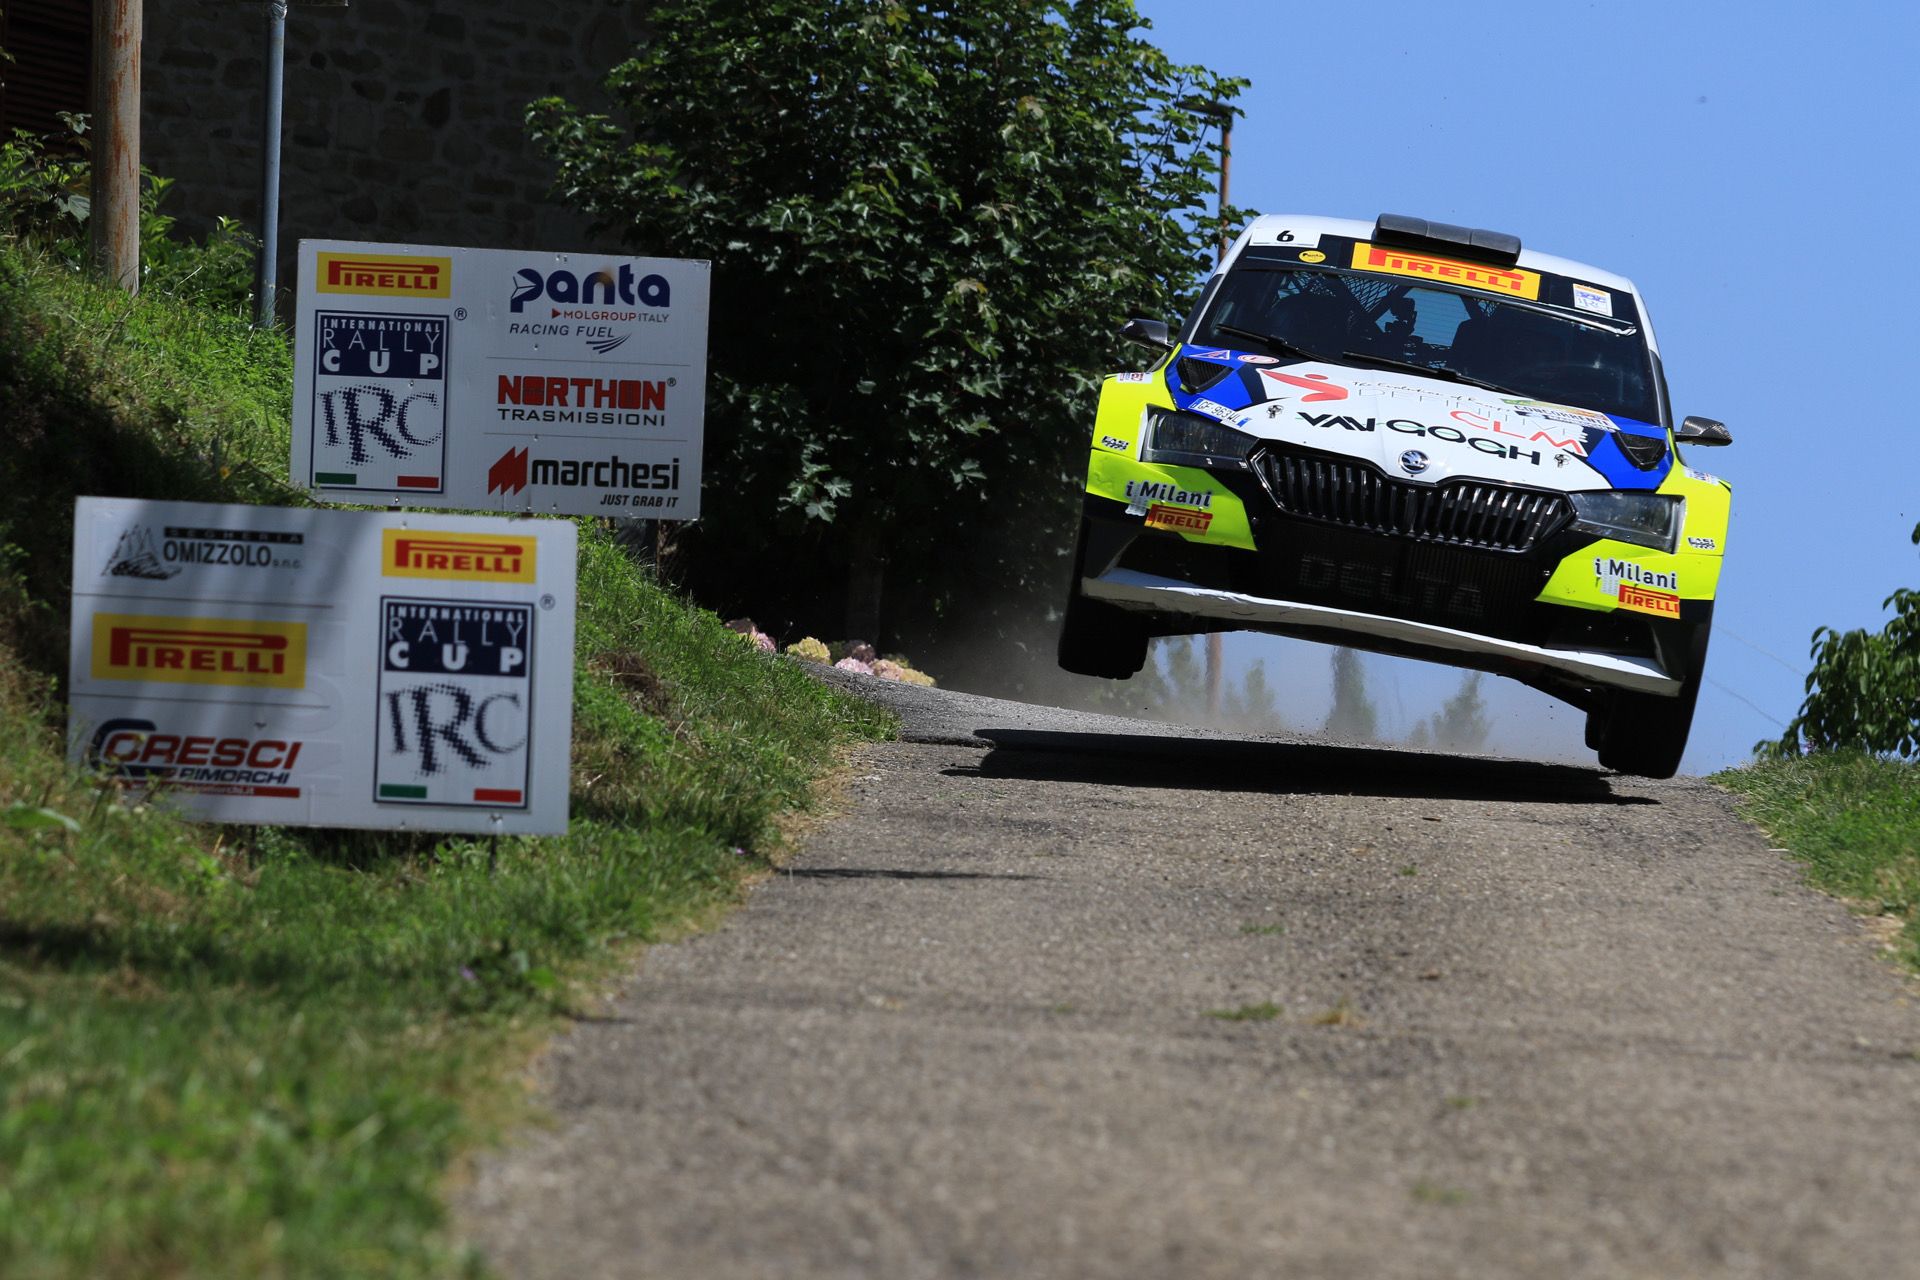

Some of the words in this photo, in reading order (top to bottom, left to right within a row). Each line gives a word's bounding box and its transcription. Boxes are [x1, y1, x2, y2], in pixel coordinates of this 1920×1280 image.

[1276, 230, 1295, 242] 6
[328, 260, 440, 290] PIRELLI
[1367, 247, 1525, 291] PIRELLI
[510, 263, 671, 313] panta
[323, 318, 440, 333] INTERNATIONAL
[509, 323, 570, 336] RACING
[576, 326, 615, 338] FUEL
[323, 328, 440, 353] RALLY
[322, 349, 439, 376] CUP
[497, 374, 666, 411] NORTHON
[497, 408, 666, 427] TRASMISSIONI
[1450, 410, 1584, 454] CLM
[531, 455, 679, 490] marchesi
[600, 494, 630, 507] JUST
[632, 495, 663, 507] GRAB
[665, 496, 679, 508] IT
[1139, 481, 1212, 507] Milani
[1147, 504, 1213, 530] PIRELLI
[163, 540, 271, 568] OMIZZOLO
[394, 538, 524, 574] PIRELLI
[1609, 559, 1677, 590] Milani
[1619, 584, 1680, 613] PIRELLI
[389, 605, 524, 623] INTERNATIONAL
[388, 618, 524, 647] RALLY
[110, 627, 288, 674] PIRELLI
[388, 640, 524, 673] CUP
[179, 766, 290, 784] RIMORCHI
